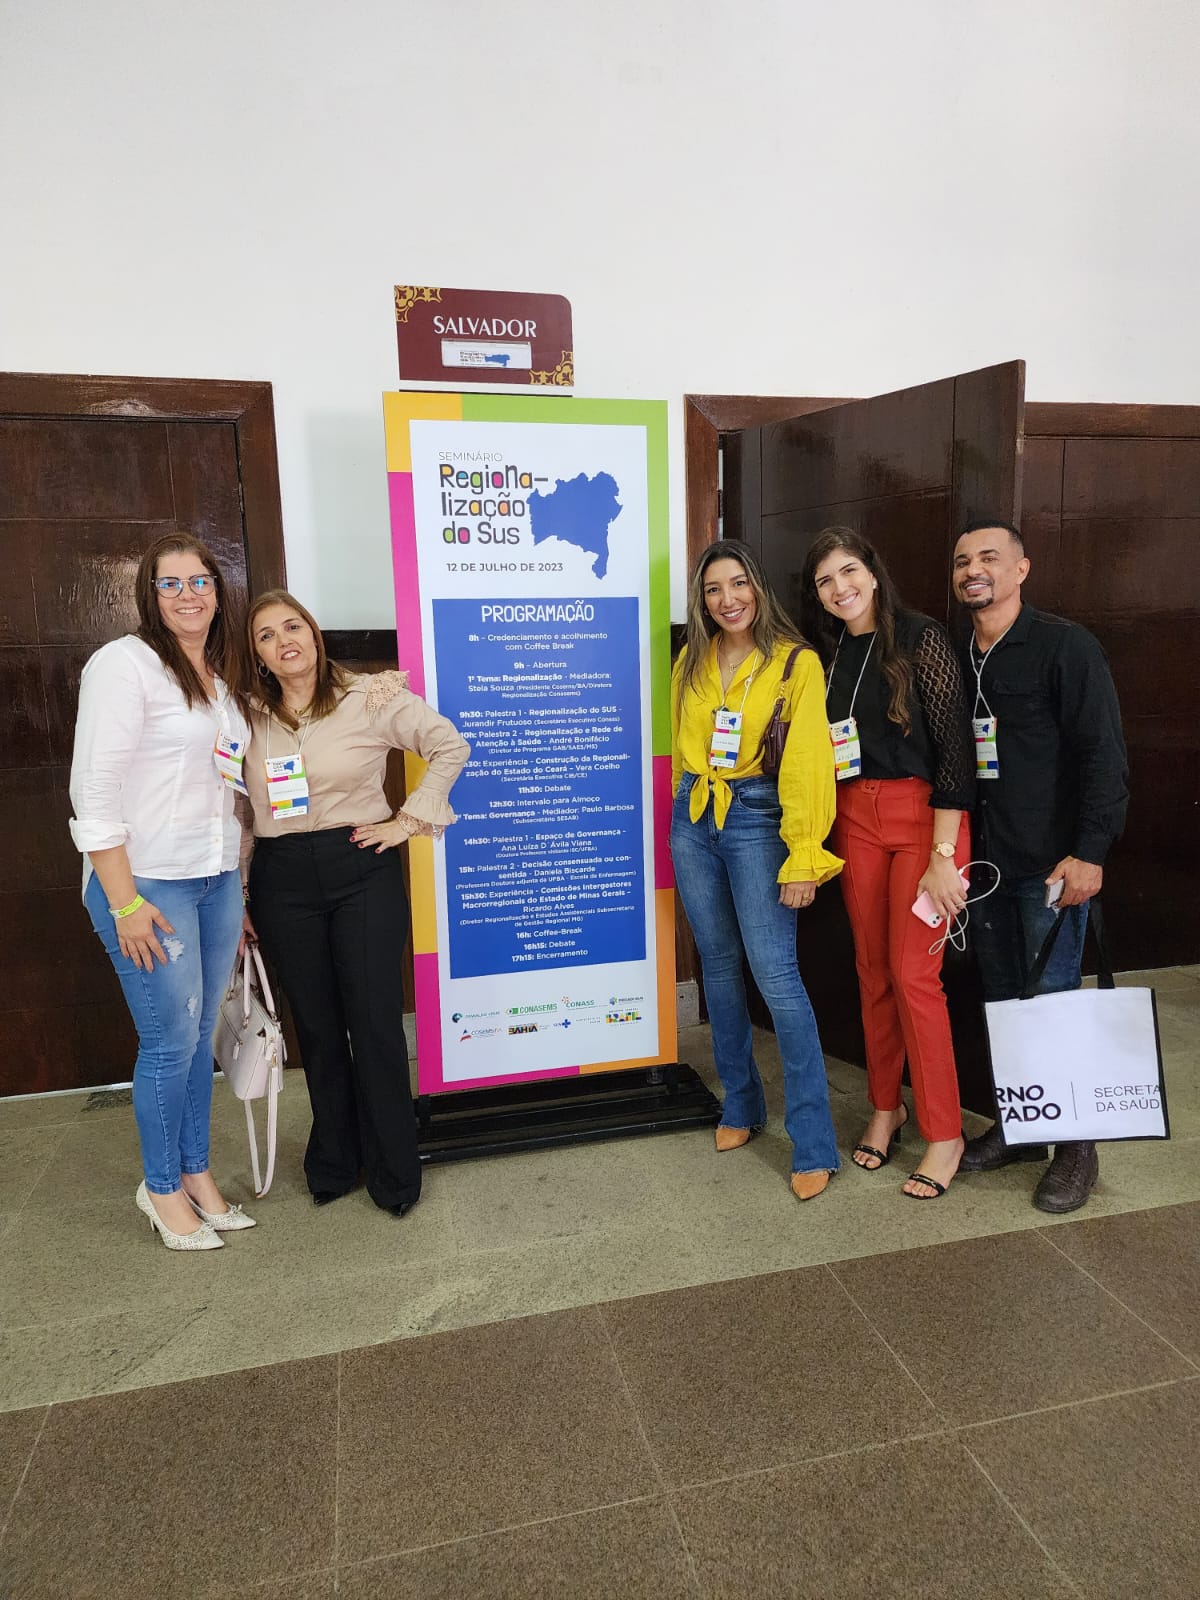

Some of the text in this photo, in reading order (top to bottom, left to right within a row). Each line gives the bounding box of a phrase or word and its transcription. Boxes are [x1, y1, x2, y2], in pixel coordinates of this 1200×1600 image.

[433, 315, 536, 337] SALVADOR
[438, 450, 503, 462] SEMINÁRIO
[441, 491, 525, 522] lização
[442, 521, 520, 545] do Sus
[446, 563, 564, 572] 12 DE JULHO DE 2023
[481, 600, 594, 623] PROGRAMAÇÃO
[487, 632, 552, 641] Credenciamento
[524, 642, 549, 650] Coffee
[532, 660, 566, 668] Abertura
[502, 673, 562, 682] Regionalização
[569, 671, 611, 679] Mediadora:
[459, 710, 483, 718] 9h30:
[485, 709, 515, 717] Palestra
[529, 706, 587, 716] Regionalização
[462, 719, 494, 727] Jurandir
[497, 718, 531, 726] Frutuoso
[478, 729, 509, 738] Palestra
[524, 727, 582, 737] Regionalização
[475, 739, 508, 748] Atenção
[518, 737, 540, 745] Saúde
[549, 736, 571, 744] André
[574, 735, 609, 743] Bonifácio
[483, 757, 528, 767] Experiência
[535, 755, 578, 765] Construção
[466, 769, 488, 777] zação
[504, 767, 530, 775] Estado
[594, 762, 620, 770] Coelho
[518, 784, 571, 793] 11h30: Debate
[517, 797, 550, 806] Intervalo
[571, 795, 600, 803] Almoço
[463, 812, 487, 820] Tema:
[489, 809, 535, 819] Governança
[542, 806, 578, 815] Mediador:
[604, 803, 633, 811] Barbosa
[463, 836, 490, 845] 14h30:
[492, 834, 522, 843] Palestra
[535, 832, 563, 841] Espaço
[577, 828, 620, 837] Governança
[571, 839, 591, 847] Viana
[458, 865, 474, 873] 15h:
[477, 863, 507, 871] Palestra
[522, 859, 551, 868] Decisão
[554, 856, 601, 866] consensuada
[498, 870, 526, 879] sentida
[534, 867, 562, 876] Daniela
[461, 880, 631, 900] 15h30: Experiência Comissões Intergestores
[462, 897, 524, 910] Macrorregionais
[539, 894, 565, 902] Estado
[579, 891, 599, 899] Minas
[602, 889, 625, 897] Gerais
[523, 902, 574, 912] Ricardo Alves
[533, 926, 582, 937] Coffee-Break
[524, 939, 575, 950] 16h15: Debate
[511, 948, 587, 962] 17h15: Encerramento
[519, 1003, 558, 1014] CONASEMS
[566, 1000, 595, 1008] CONASS
[508, 1024, 538, 1035] BAHIA
[995, 1085, 1044, 1103] RNO
[1094, 1084, 1160, 1098] SECRETA
[1096, 1097, 1160, 1112] DA SAÚD
